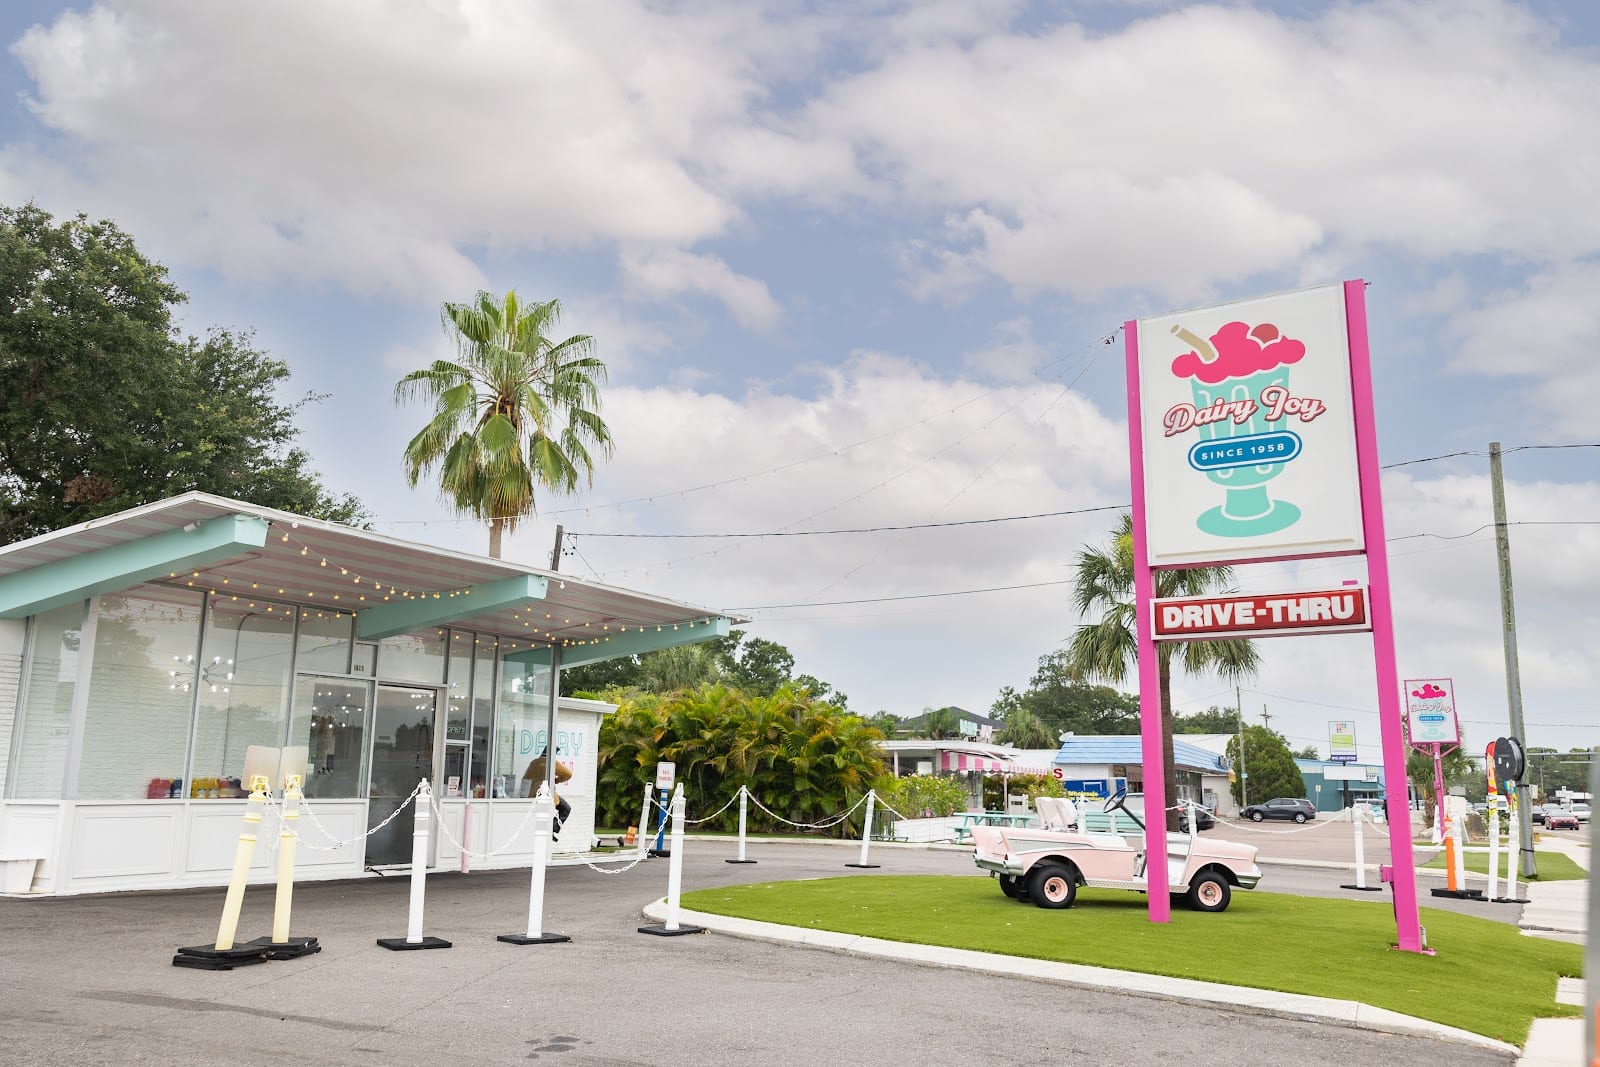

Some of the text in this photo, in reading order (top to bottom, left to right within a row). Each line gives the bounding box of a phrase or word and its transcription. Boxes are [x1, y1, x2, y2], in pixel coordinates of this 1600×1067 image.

[1163, 385, 1327, 437] Dairy Joy
[1201, 443, 1285, 461] SINCE 1958
[1162, 595, 1355, 629] DRIVE-THRU
[520, 729, 583, 756] DARY
